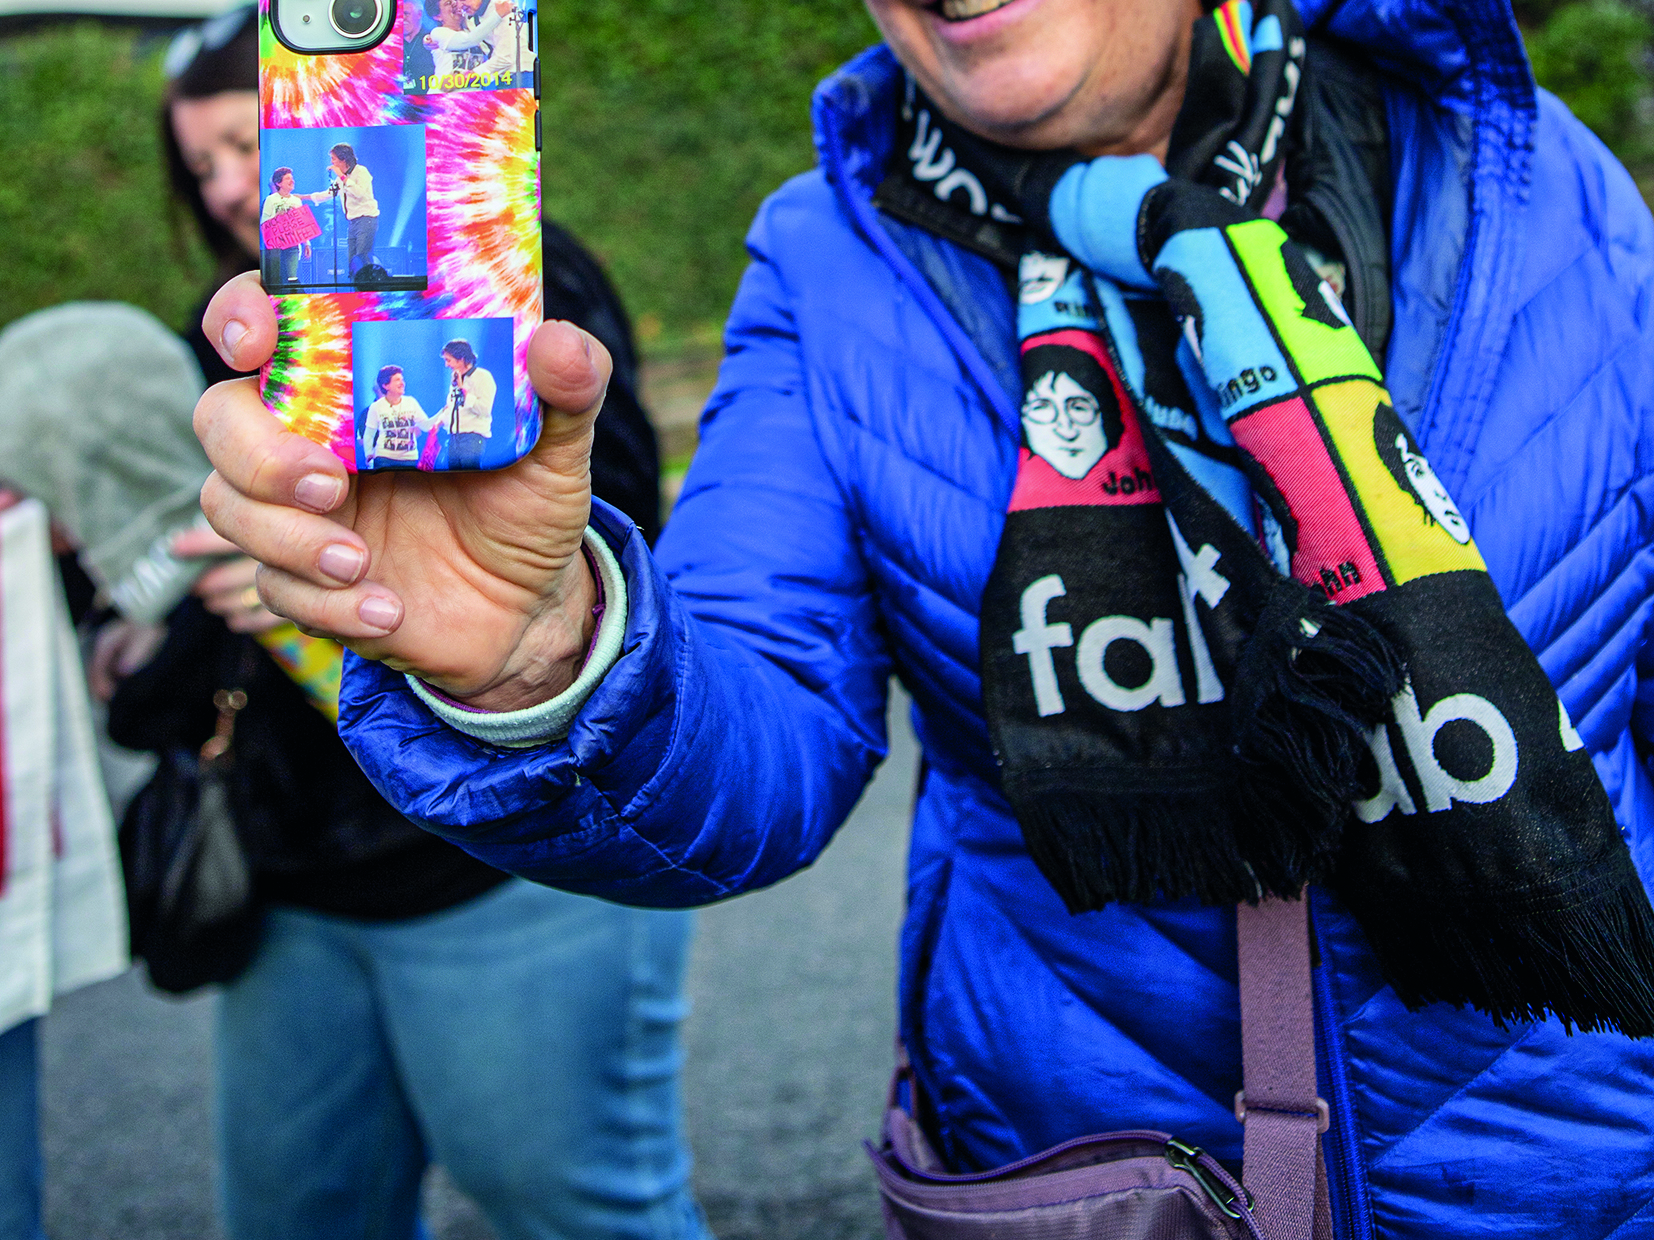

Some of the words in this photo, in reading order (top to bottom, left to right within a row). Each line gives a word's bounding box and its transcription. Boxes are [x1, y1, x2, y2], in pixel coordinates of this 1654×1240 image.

[419, 70, 513, 91] 10/30/2014
[1217, 365, 1277, 409] ingo
[1102, 467, 1152, 496] Joh
[1318, 560, 1362, 598] hn
[1350, 674, 1519, 824] ab
